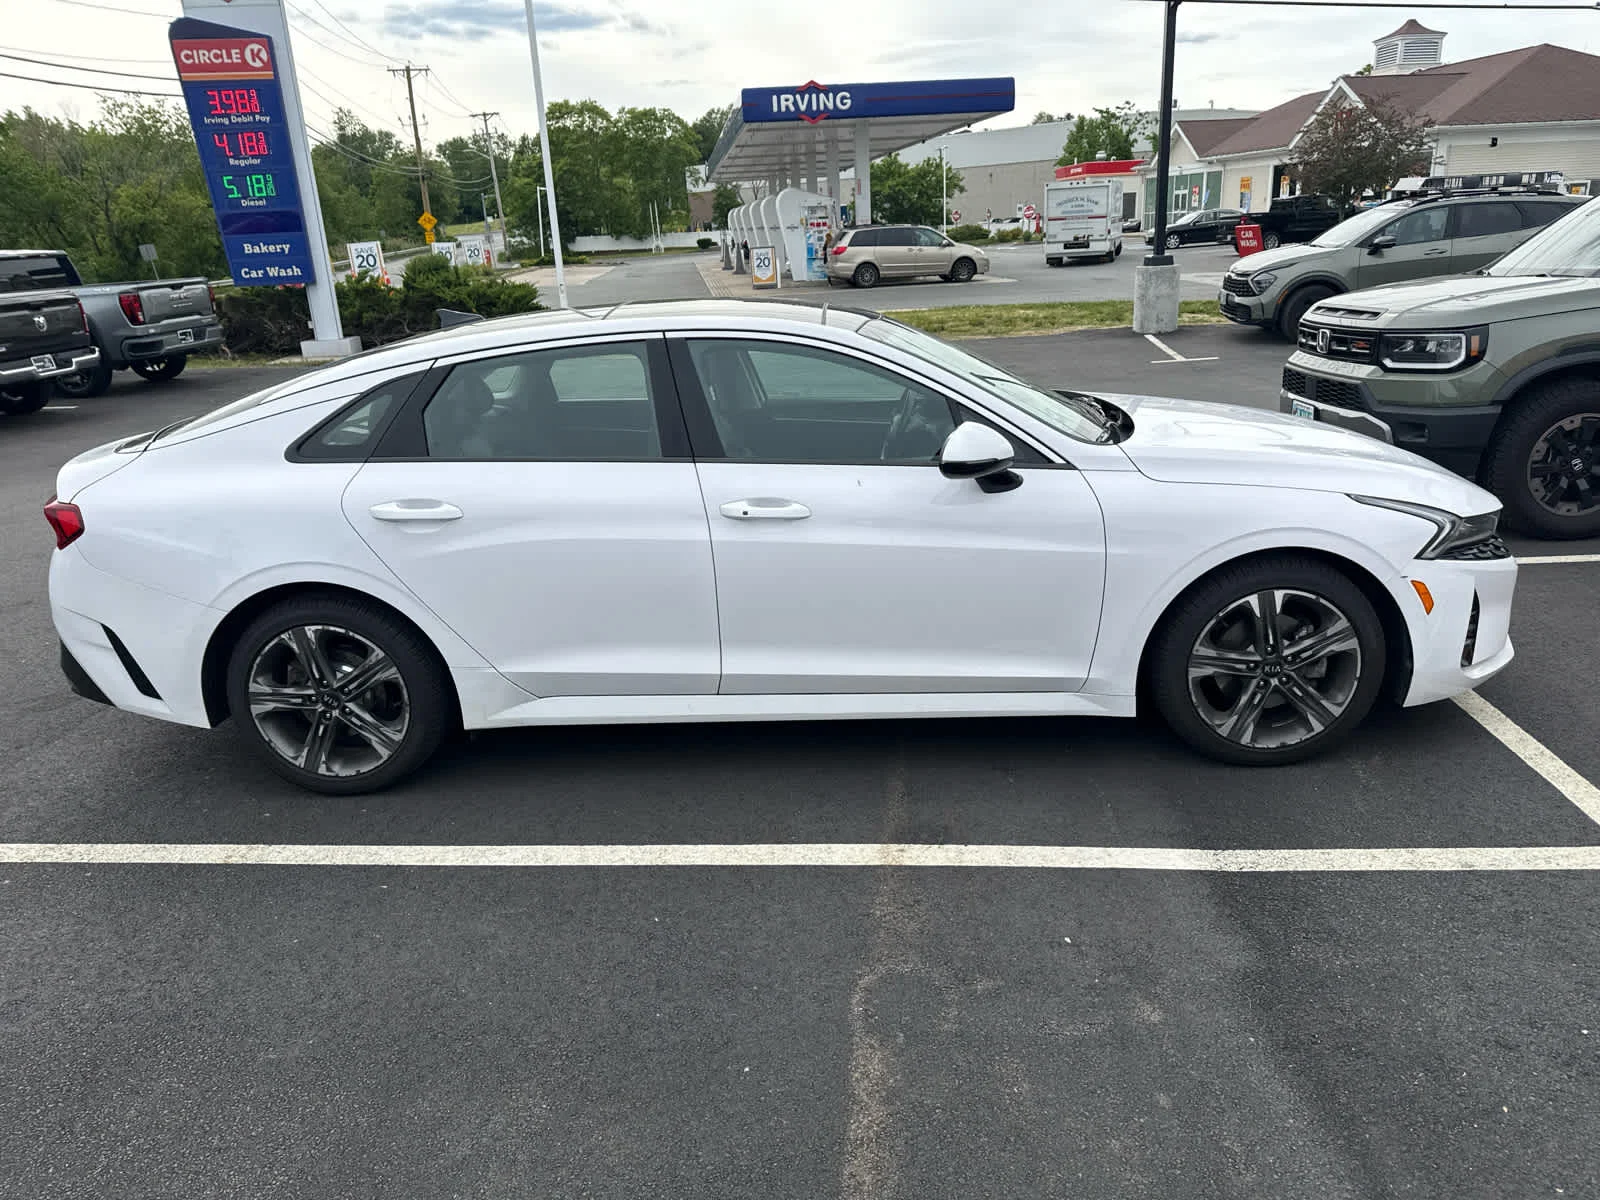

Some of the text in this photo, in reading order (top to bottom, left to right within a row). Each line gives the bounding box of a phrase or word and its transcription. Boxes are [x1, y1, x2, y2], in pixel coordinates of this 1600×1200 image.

[181, 43, 268, 68] CIRCLE K
[772, 91, 852, 113] IRVING
[204, 114, 271, 125] Irving Debit Pay
[228, 157, 261, 166] Regular
[241, 199, 267, 207] Diesel
[1240, 230, 1254, 239] CAR
[243, 242, 290, 255] Bakery
[1240, 239, 1258, 248] WASH
[467, 247, 480, 258] 20
[355, 253, 377, 269] 20
[755, 256, 771, 268] 20
[241, 265, 302, 279] Car Wash
[1264, 665, 1281, 673] KIA
